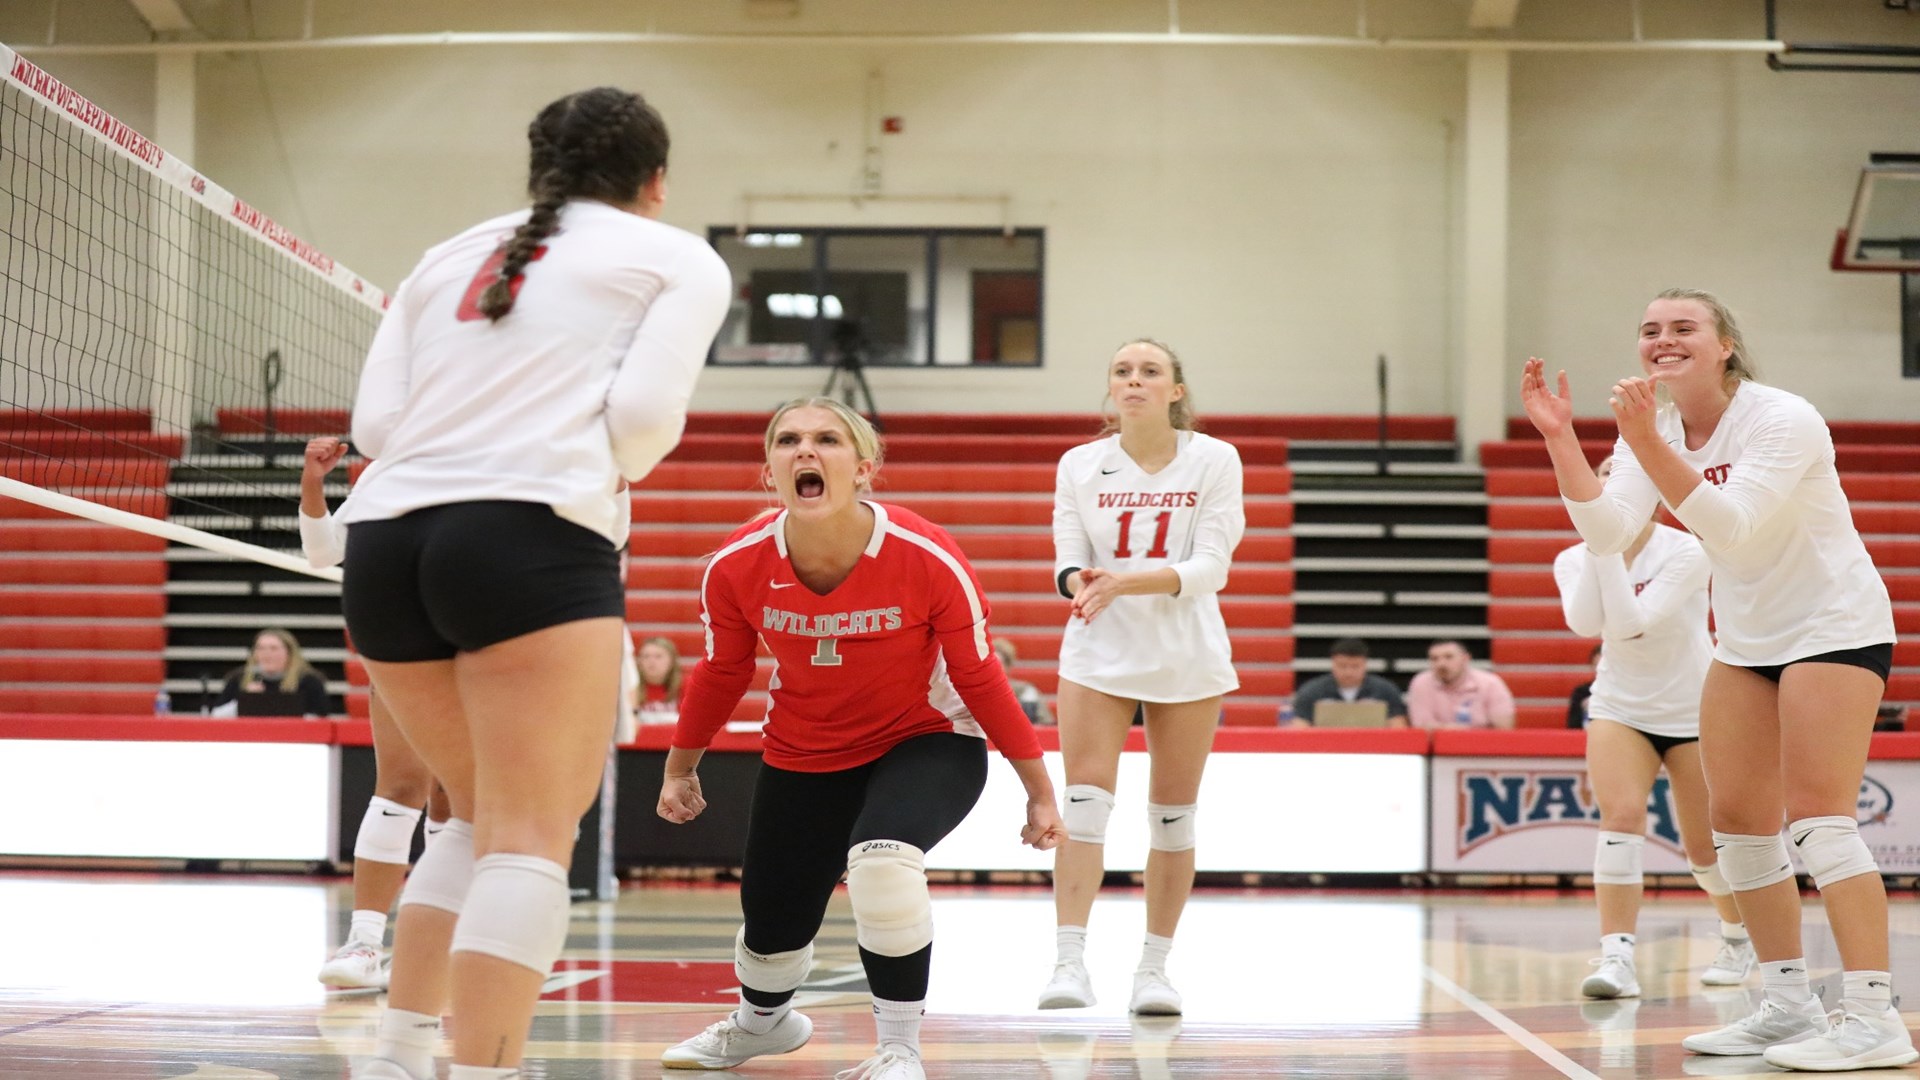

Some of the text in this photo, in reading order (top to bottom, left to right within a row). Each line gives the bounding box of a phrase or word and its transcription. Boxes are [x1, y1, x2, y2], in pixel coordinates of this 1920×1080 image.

[1098, 491, 1198, 508] WILDCATS
[1114, 511, 1172, 559] 11
[762, 606, 902, 637] WILDCATS
[811, 638, 842, 666] 1
[1465, 777, 1680, 844] NAA
